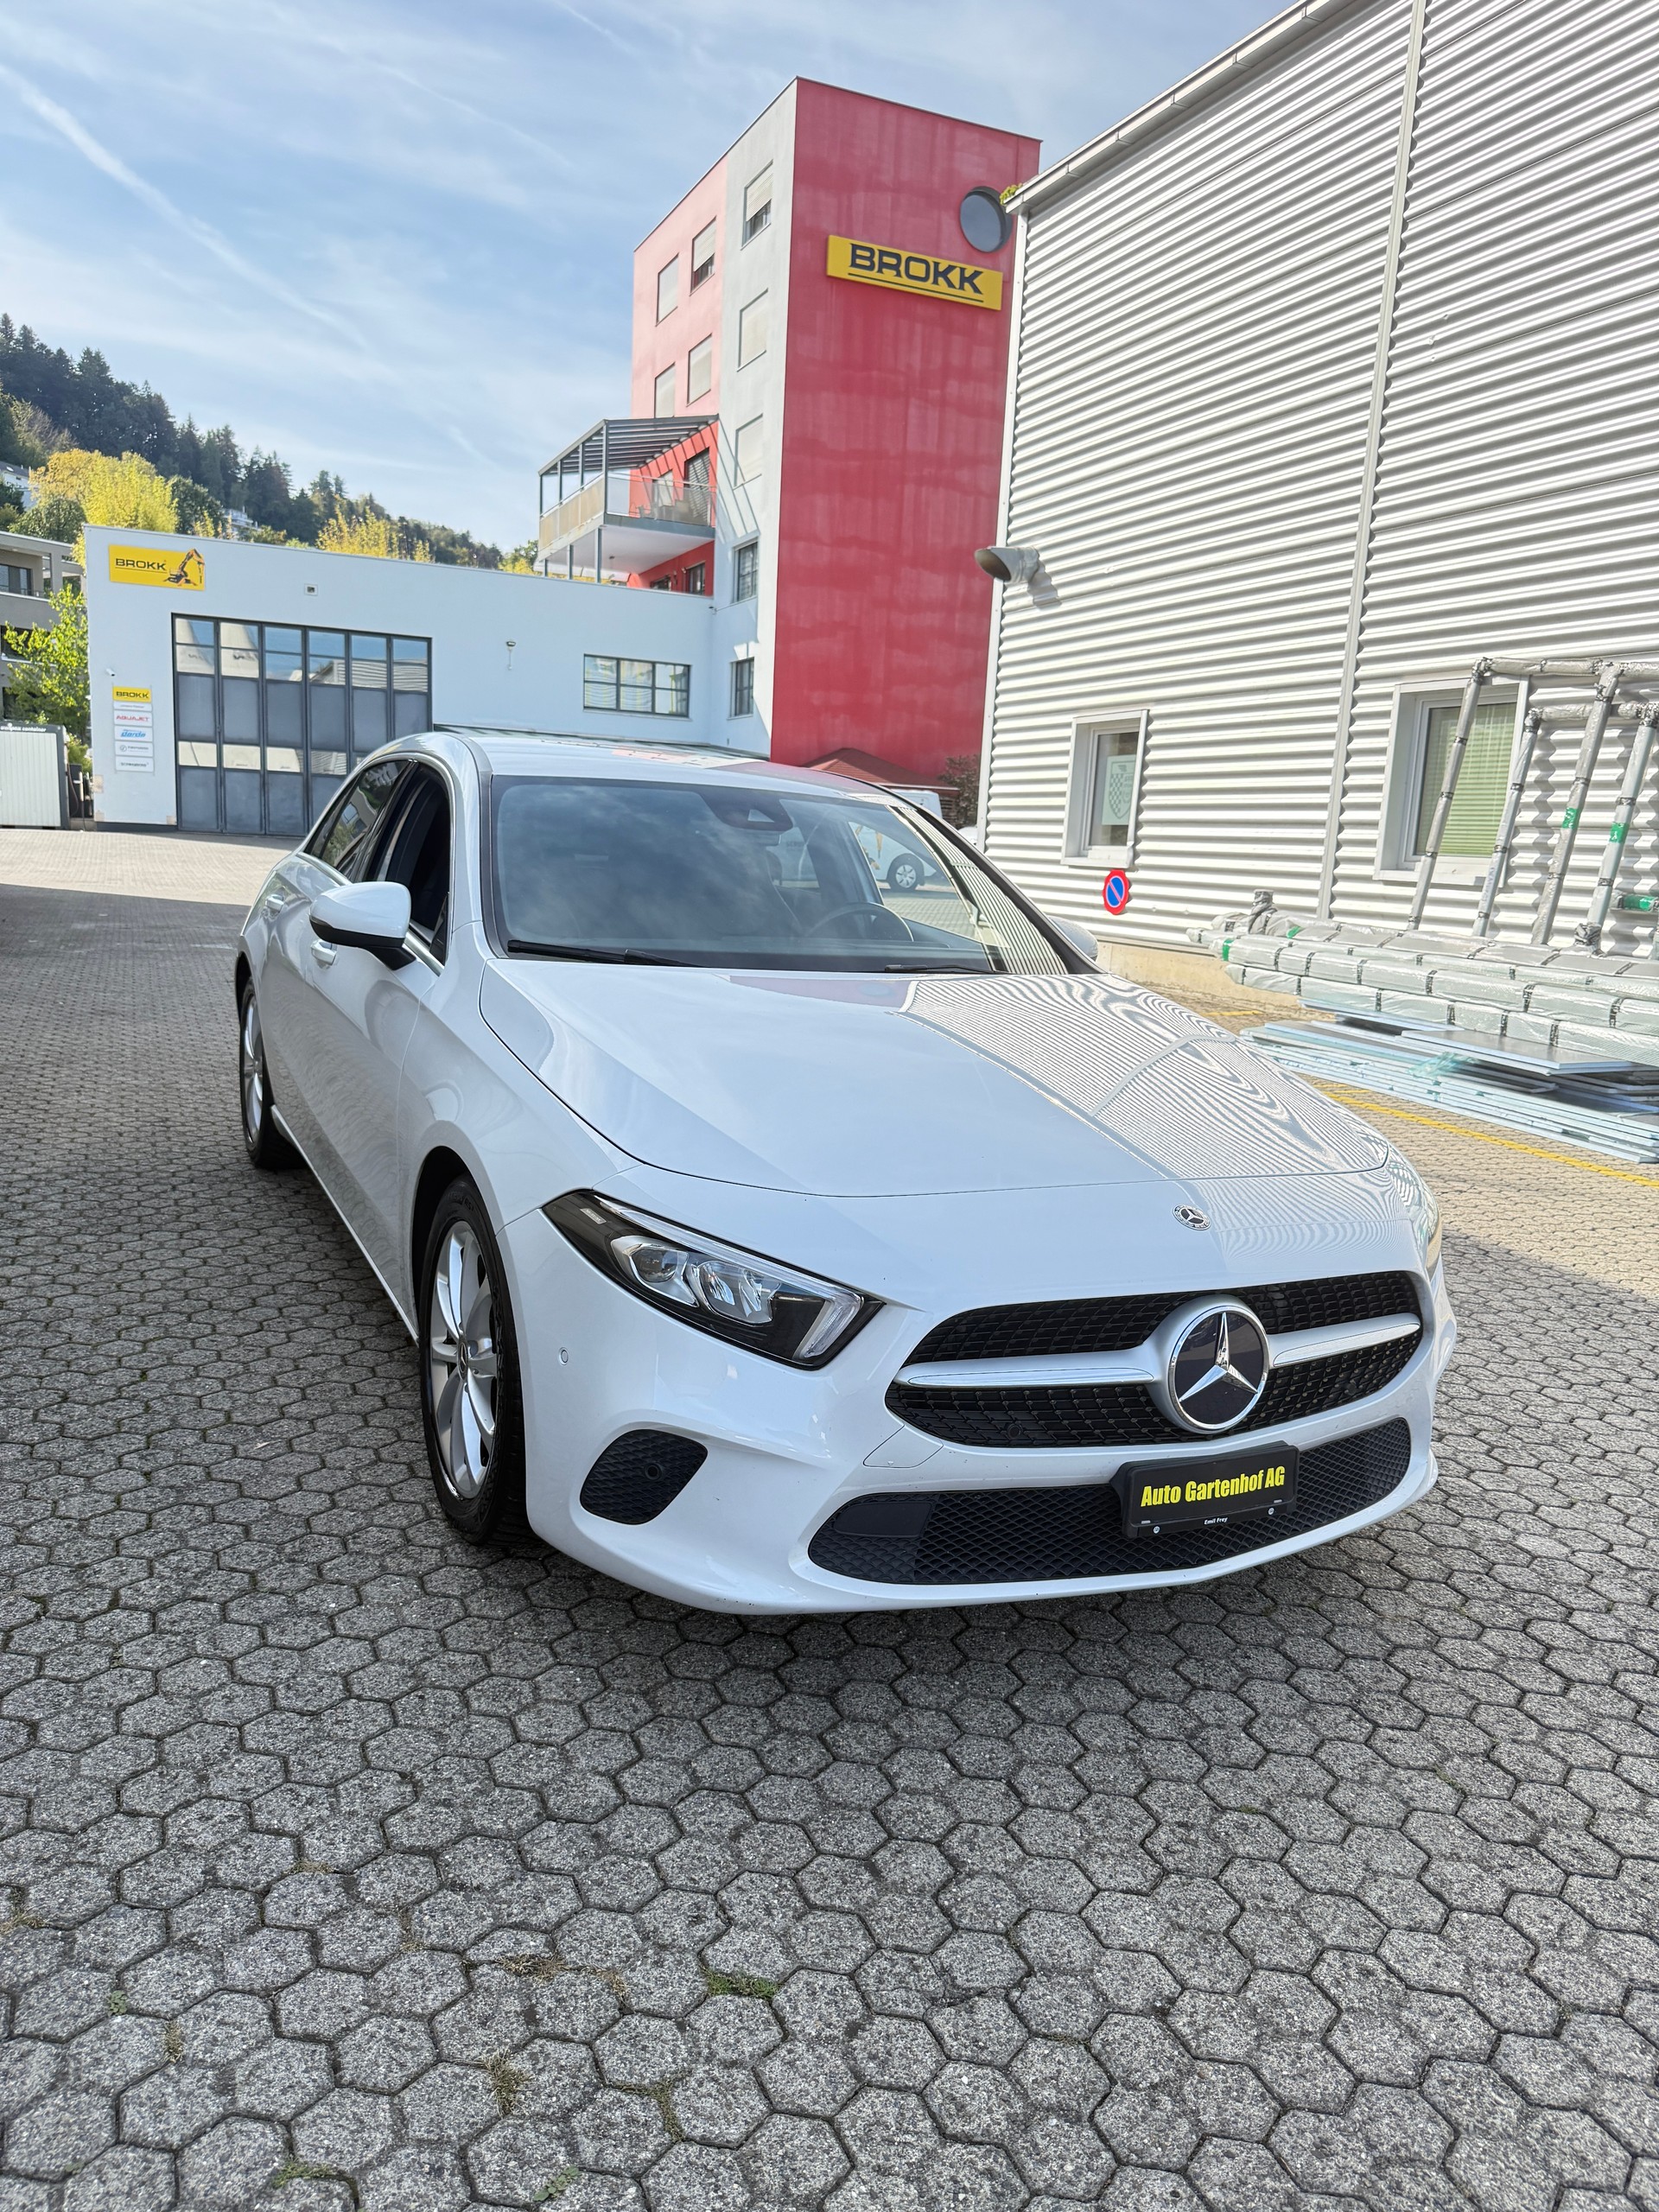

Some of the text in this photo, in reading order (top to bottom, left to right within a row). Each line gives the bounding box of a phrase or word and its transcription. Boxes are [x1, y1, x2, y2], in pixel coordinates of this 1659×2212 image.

[849, 243, 984, 296] BROKK
[115, 558, 167, 571] BROKK
[116, 690, 149, 699] BROKK
[1141, 1465, 1286, 1507] Auto Gartenhof AG
